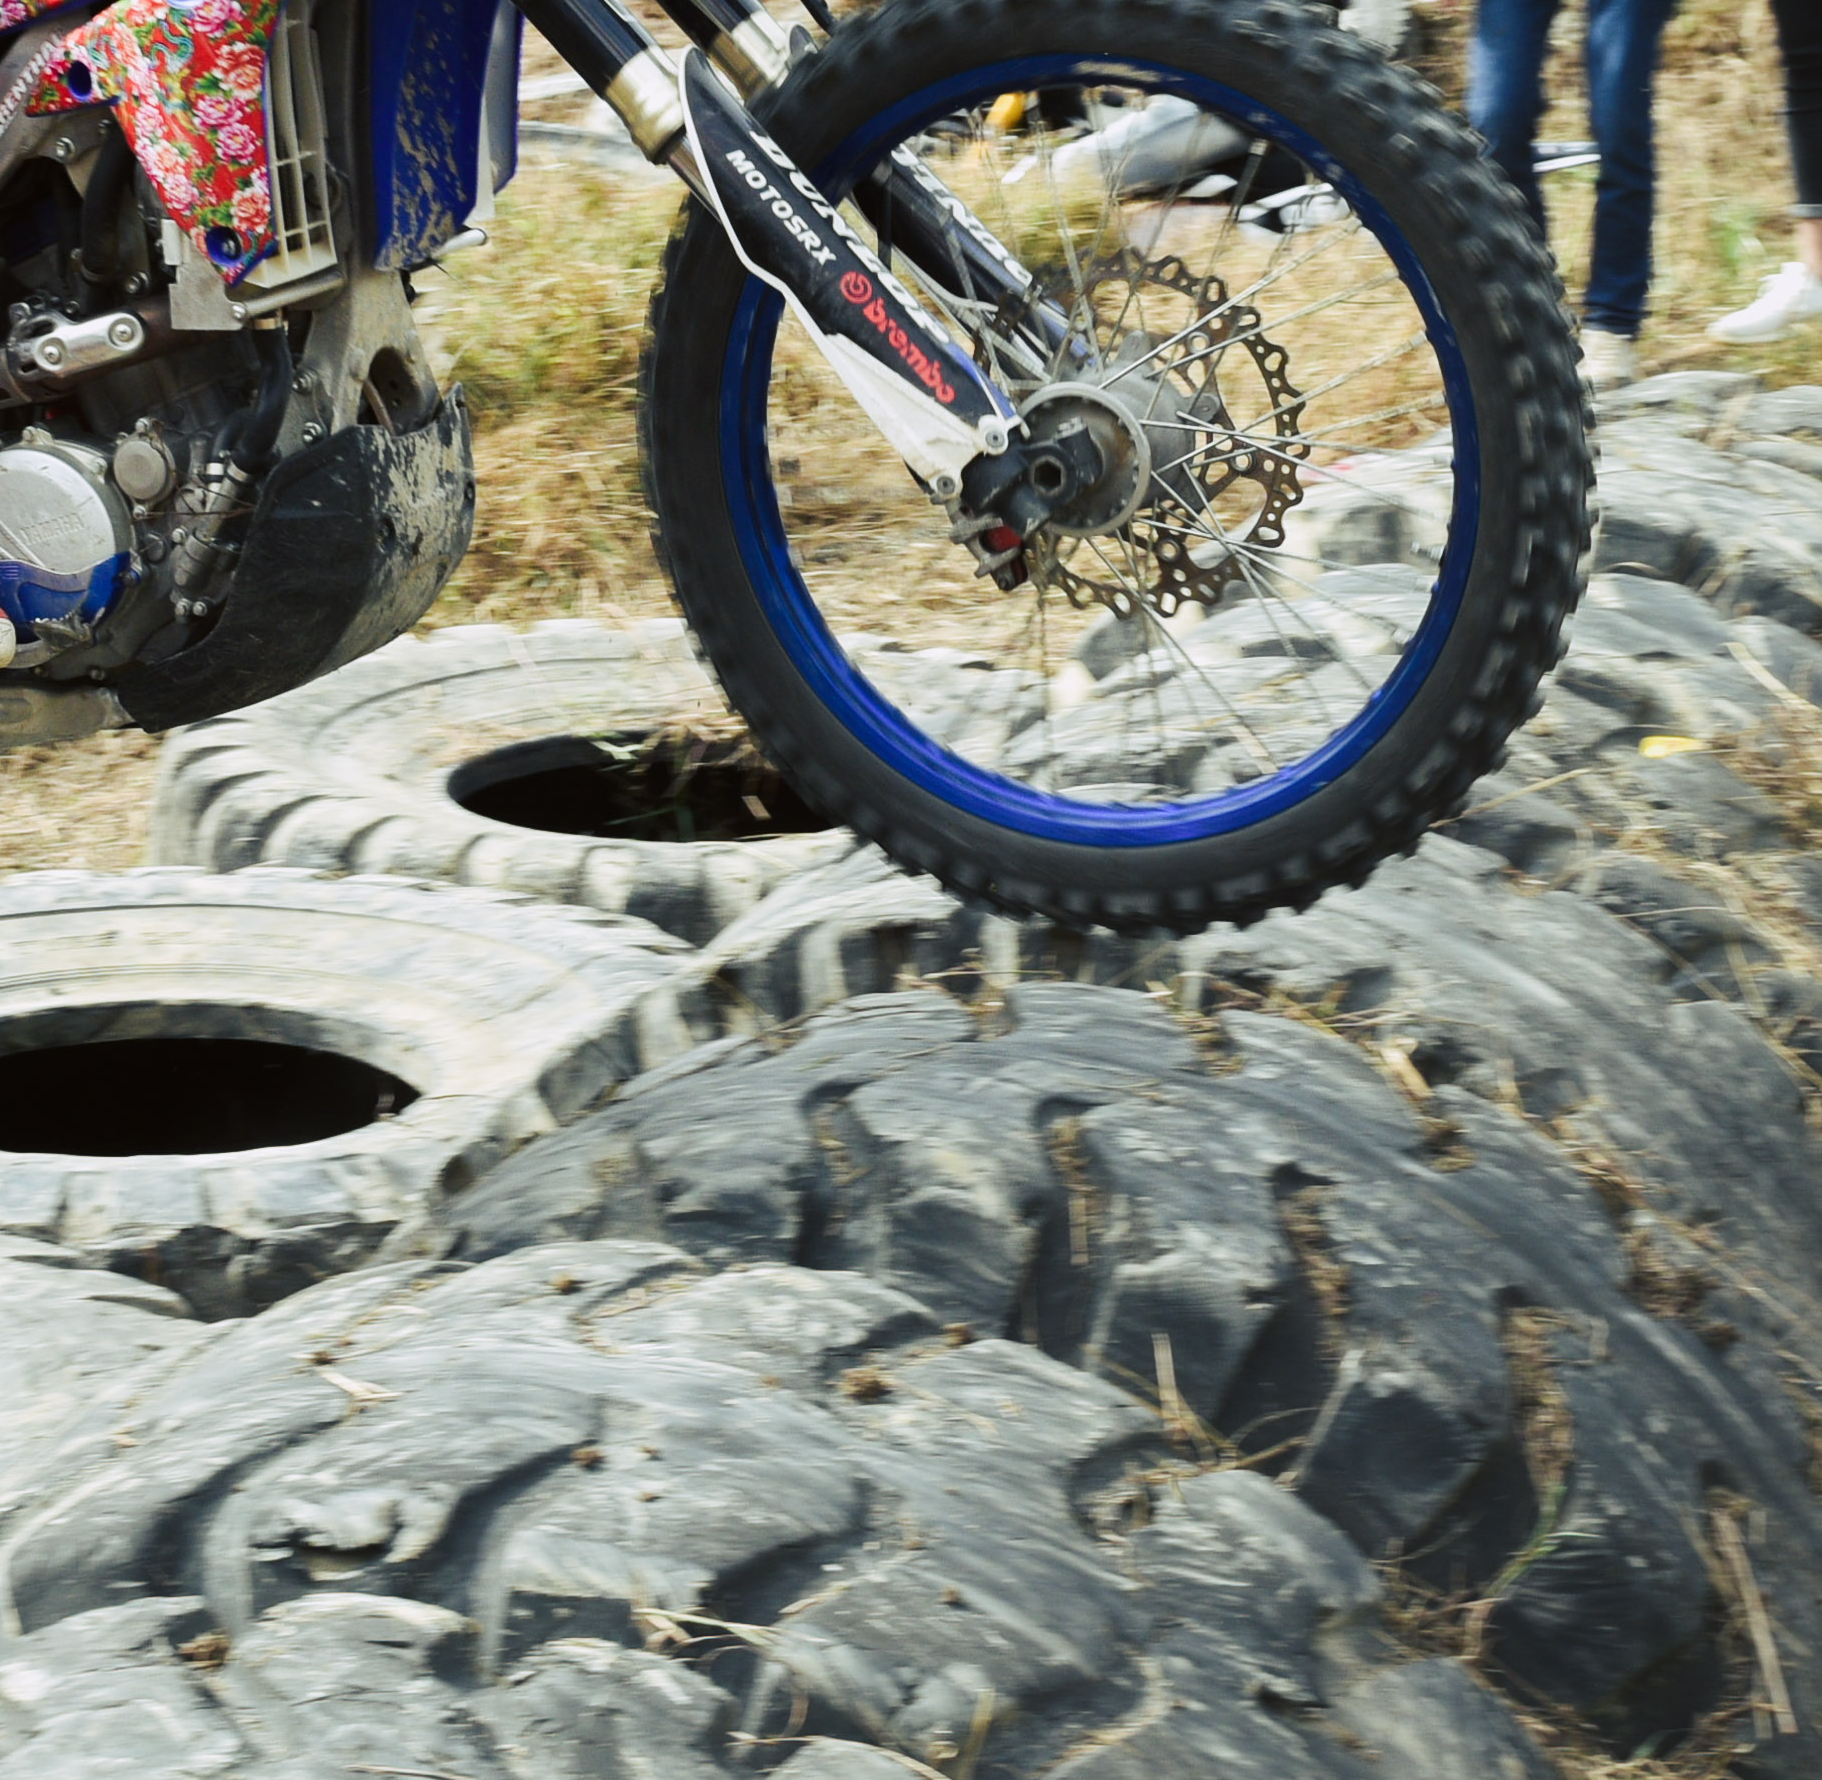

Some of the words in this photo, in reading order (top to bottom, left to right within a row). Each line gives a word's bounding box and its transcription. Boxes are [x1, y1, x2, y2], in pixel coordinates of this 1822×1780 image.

[725, 149, 837, 266] MOTOSRX
[749, 130, 951, 344] DUNLOP
[890, 142, 1034, 288] DUNLO
[862, 297, 957, 404] brembo
